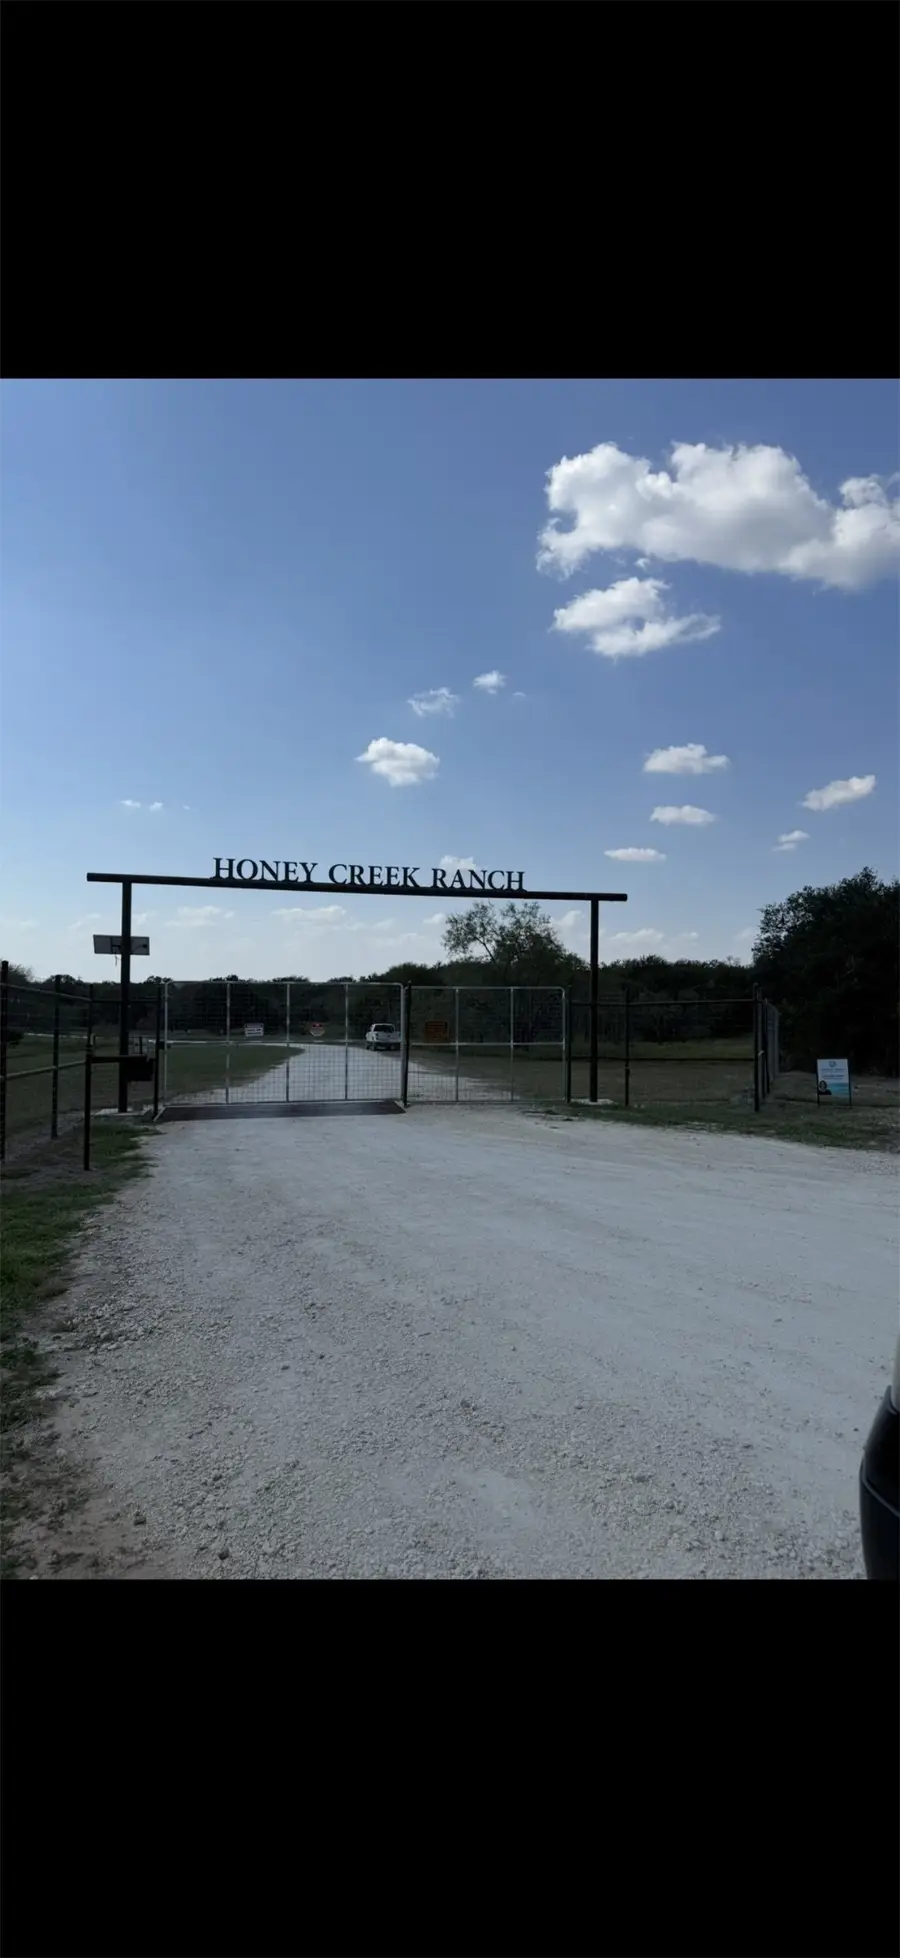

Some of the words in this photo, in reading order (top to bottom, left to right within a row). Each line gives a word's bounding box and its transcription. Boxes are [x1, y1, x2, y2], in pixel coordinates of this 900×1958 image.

[212, 857, 318, 883] HONEY
[328, 863, 420, 888] CREEK
[431, 868, 526, 892] RANCH
